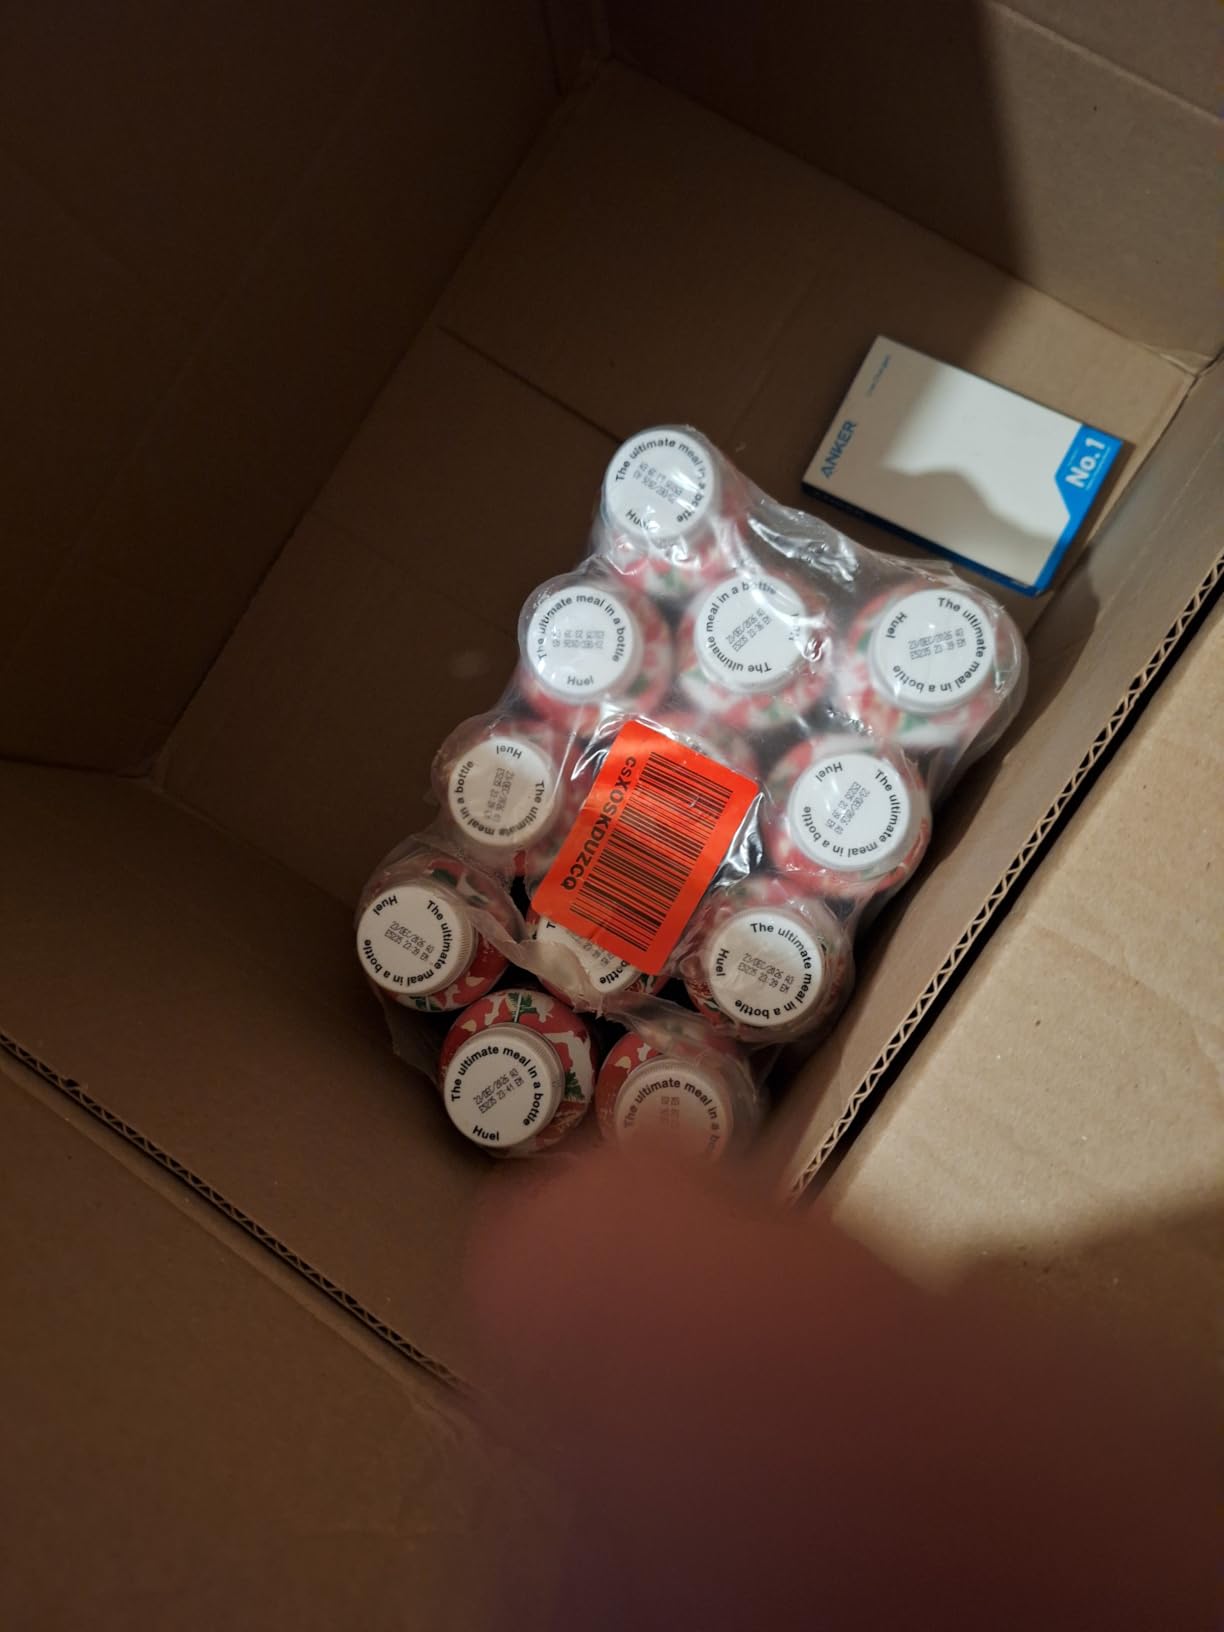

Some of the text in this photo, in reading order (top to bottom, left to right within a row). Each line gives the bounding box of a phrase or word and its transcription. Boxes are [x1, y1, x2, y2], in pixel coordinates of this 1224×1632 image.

[616, 461, 630, 481] The
[629, 438, 675, 459] ultimate
[678, 444, 703, 466] meal
[821, 420, 857, 478] ANKER
[1065, 437, 1105, 488] No.1
[576, 595, 605, 607] meal
[719, 593, 730, 603] in
[937, 598, 960, 611] The
[538, 597, 572, 634] ultimate
[605, 604, 617, 616] in
[706, 603, 719, 632] meal
[886, 612, 907, 638] Huel
[963, 610, 986, 657] ultimate
[536, 638, 547, 660] The
[612, 626, 626, 662] bottle
[708, 636, 744, 671] ultimate
[748, 662, 772, 673] The
[893, 665, 924, 692] bottle
[955, 661, 980, 688] meal
[567, 675, 594, 685] Huel
[940, 683, 952, 691] in
[497, 745, 522, 759] Huel
[455, 761, 474, 793] bottle
[816, 762, 843, 782] Huel
[875, 770, 892, 791] The
[535, 781, 544, 803] The
[460, 807, 469, 819] in
[499, 807, 538, 836] ultimate
[802, 806, 822, 842] bottle
[879, 795, 901, 842] ultimate
[467, 818, 495, 835] meal
[833, 845, 844, 856] in
[848, 842, 878, 857] meal
[373, 896, 398, 915] Huel
[427, 900, 443, 920] The
[751, 923, 774, 933] The
[363, 940, 383, 973] bottle
[434, 923, 452, 969] ultimate
[778, 928, 812, 969] ultimate
[600, 960, 630, 984] bottle
[716, 948, 730, 976] Huel
[393, 975, 403, 985] in
[407, 969, 434, 986] meal
[795, 974, 812, 1003] meal
[735, 1000, 769, 1019] bottle
[784, 1002, 797, 1011] in
[458, 1046, 499, 1075] ultimate
[503, 1047, 531, 1066] meal
[528, 1066, 538, 1078] in
[451, 1079, 462, 1102] The
[635, 1078, 681, 1104] ultimate
[684, 1083, 713, 1106] meal
[708, 1106, 717, 1119] in
[523, 1093, 544, 1126] bottle
[473, 1126, 499, 1141] Huel
